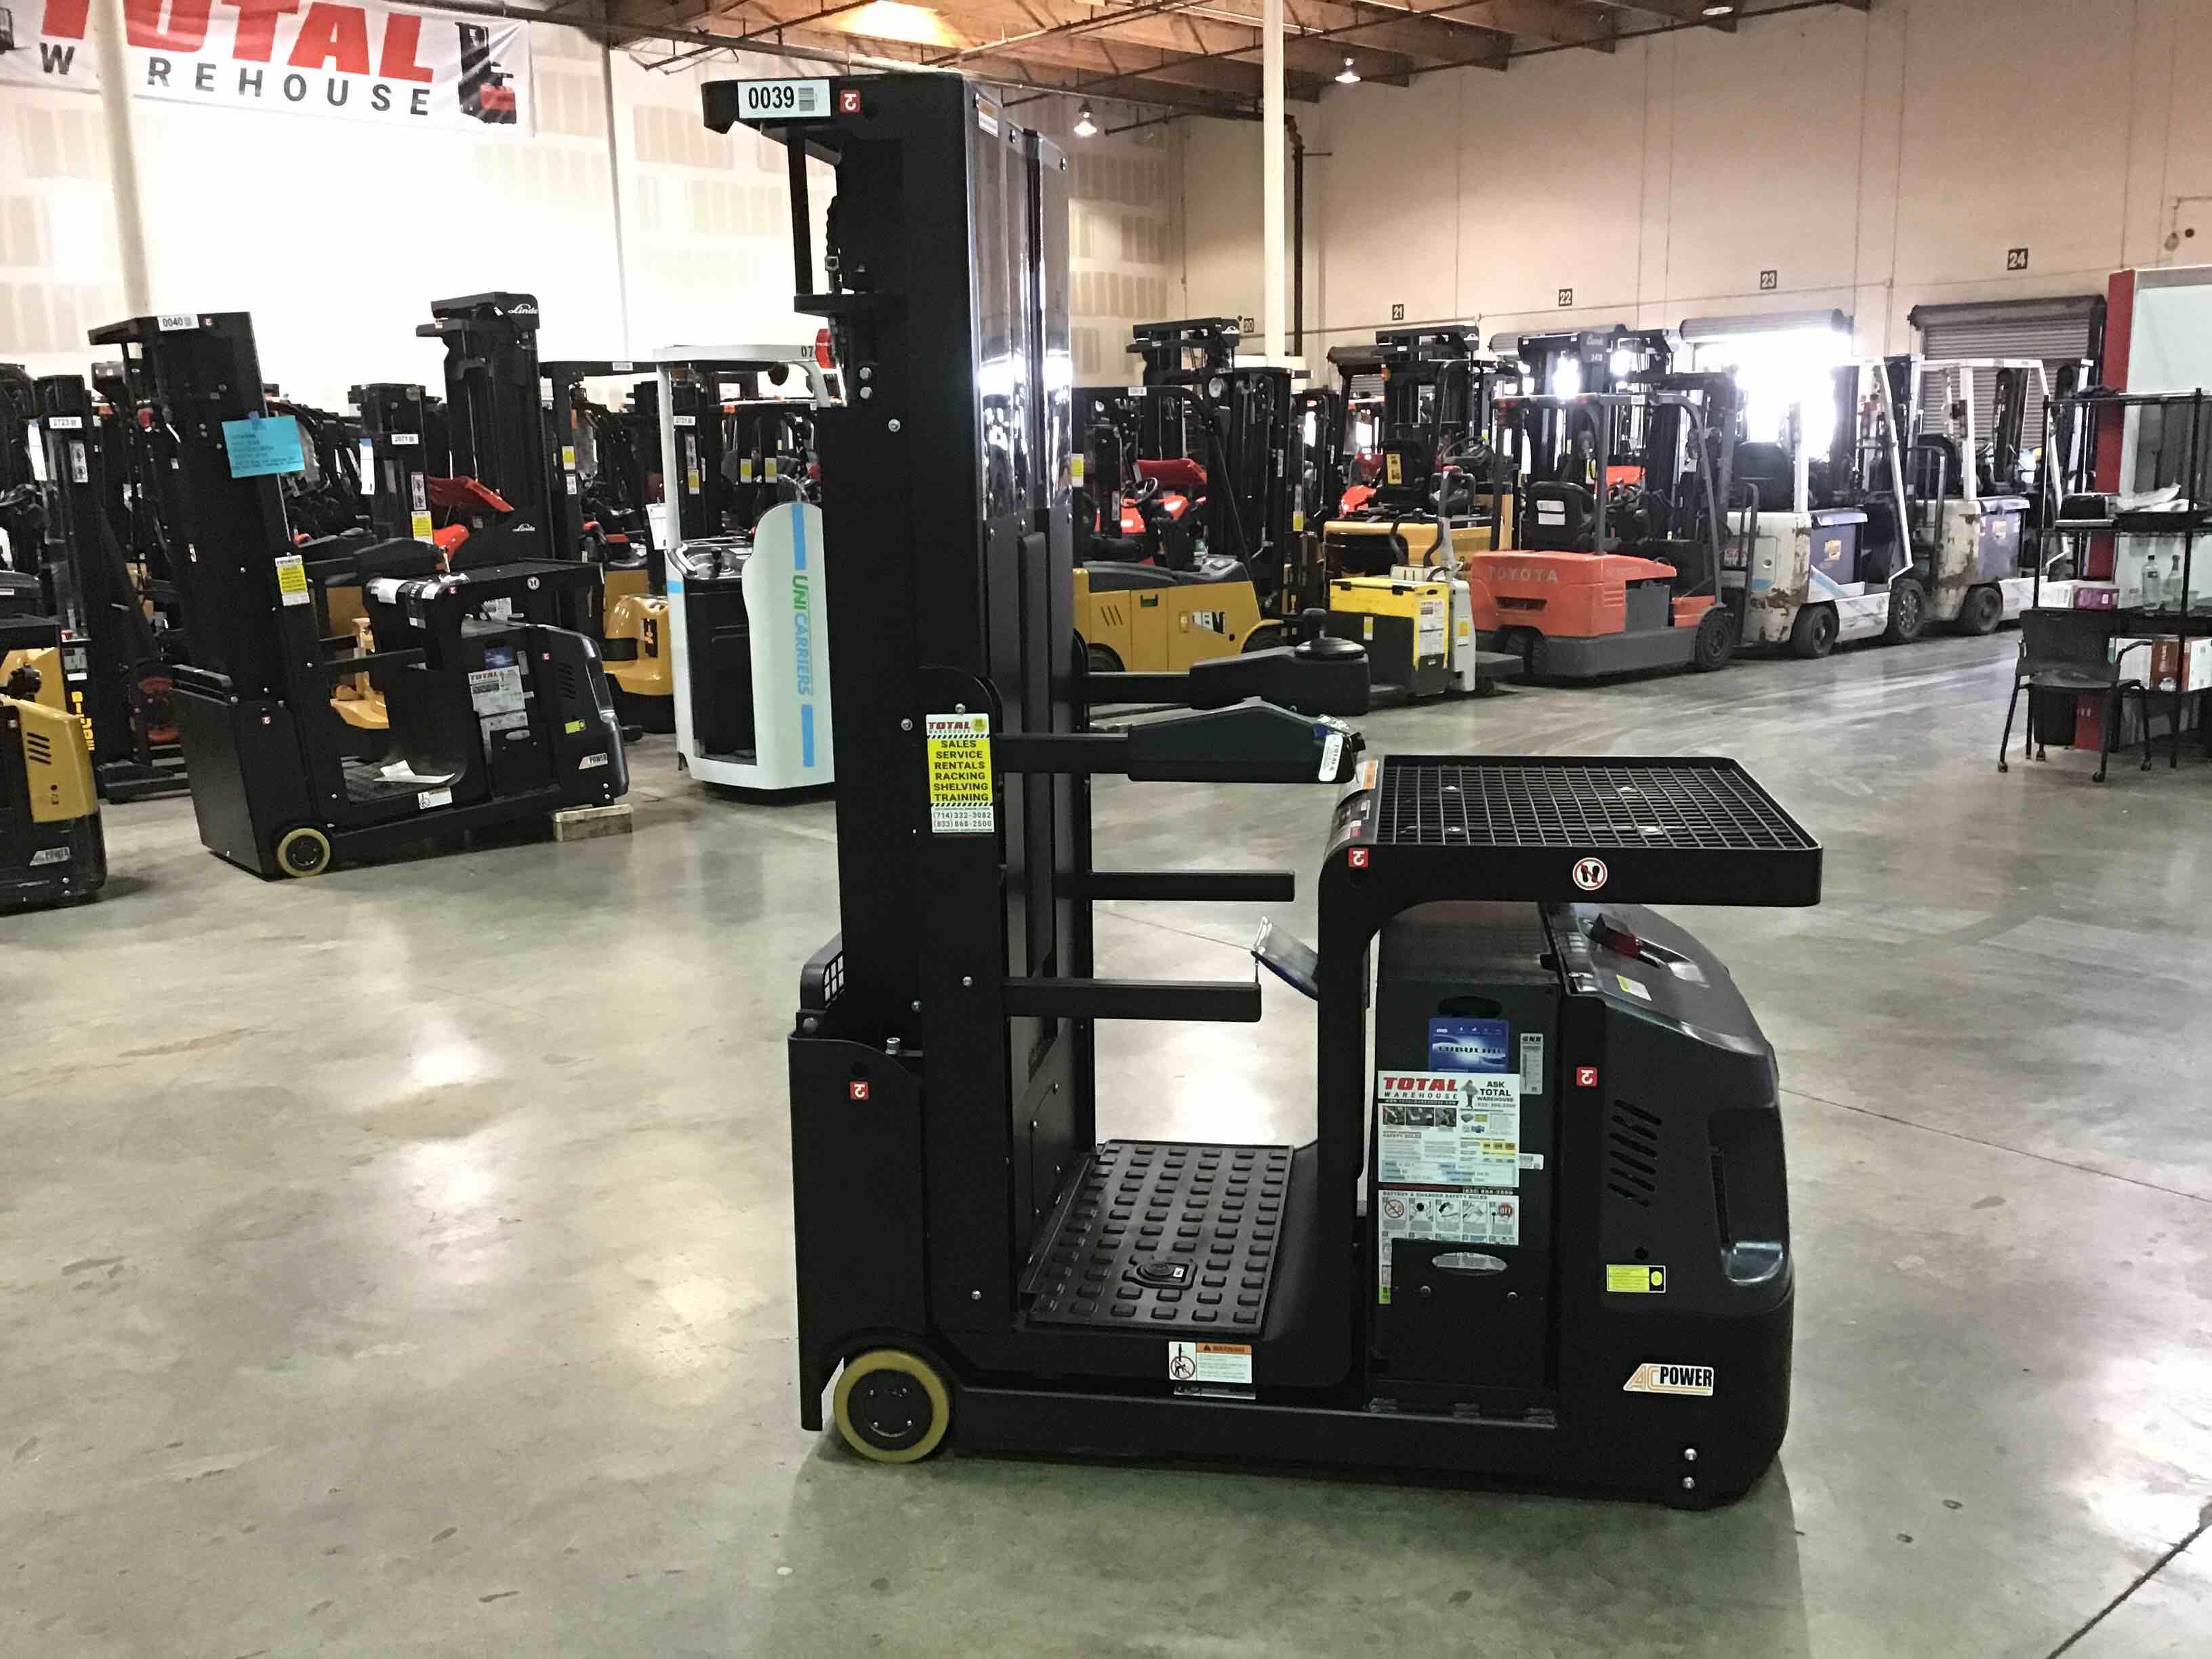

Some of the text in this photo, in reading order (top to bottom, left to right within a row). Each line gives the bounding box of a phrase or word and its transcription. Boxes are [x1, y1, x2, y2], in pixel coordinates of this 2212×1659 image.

[39, 42, 432, 117] WREHOUSE
[748, 86, 794, 109] 0039
[2009, 251, 2026, 268] 24
[1761, 272, 1775, 287] 23
[1559, 289, 1572, 304] 22
[508, 303, 539, 314] Linde
[1393, 305, 1404, 319] 21
[163, 316, 183, 327] 0040
[1488, 565, 1558, 583] TOYOTA
[928, 721, 970, 730] TOTAL
[941, 739, 977, 748] SALES
[936, 750, 983, 758] SERVICE
[935, 761, 985, 769] RENTALS
[935, 772, 985, 780] RACKING
[933, 782, 988, 791] SHELVING
[934, 793, 989, 802] TRAINING
[1383, 1077, 1458, 1091] TOTAL
[1479, 1088, 1511, 1097] TOTAL
[1660, 1366, 1712, 1387] POWER
